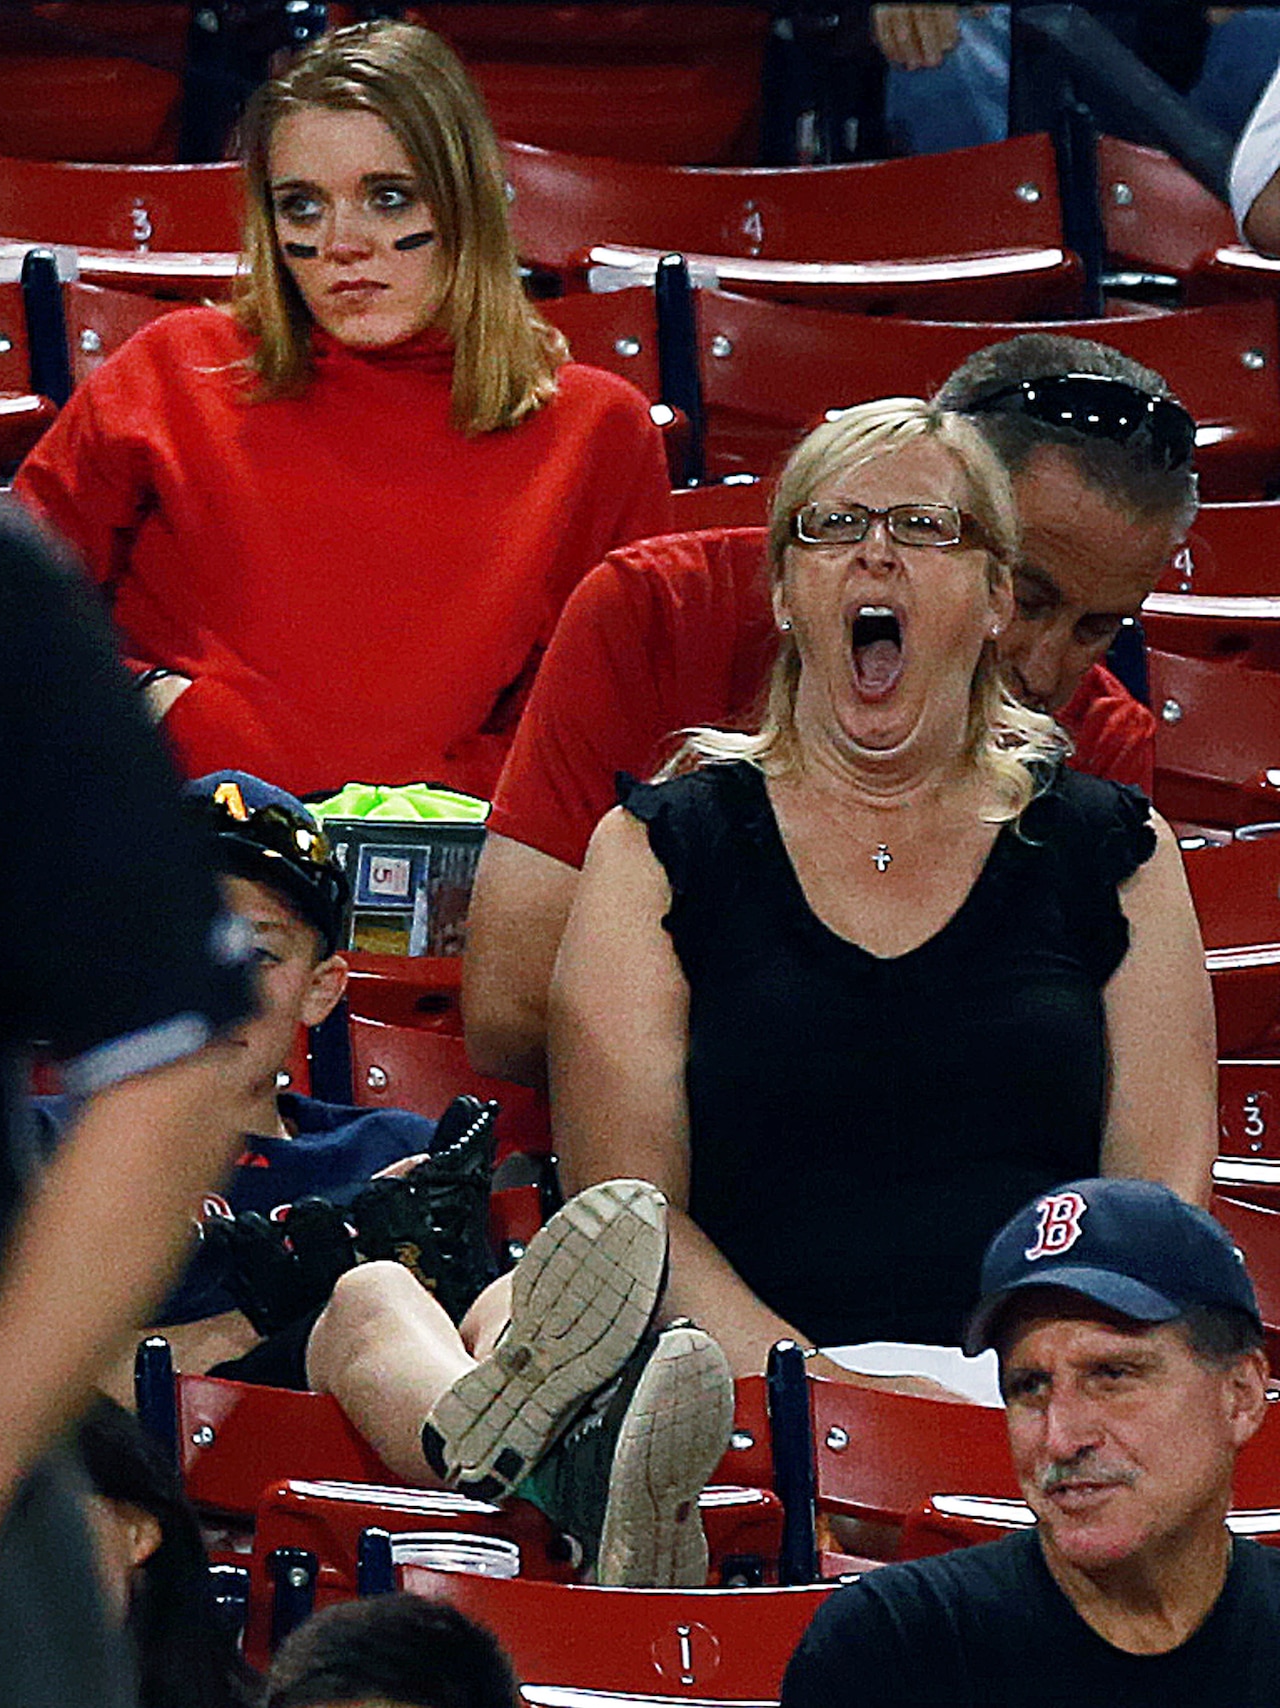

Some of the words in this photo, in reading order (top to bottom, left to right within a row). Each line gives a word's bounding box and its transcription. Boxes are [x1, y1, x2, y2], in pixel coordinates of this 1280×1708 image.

[131, 209, 151, 240] 3
[744, 212, 763, 241] 4
[1174, 548, 1194, 577] 4
[1243, 1106, 1264, 1136] 3
[1025, 1192, 1088, 1261] B
